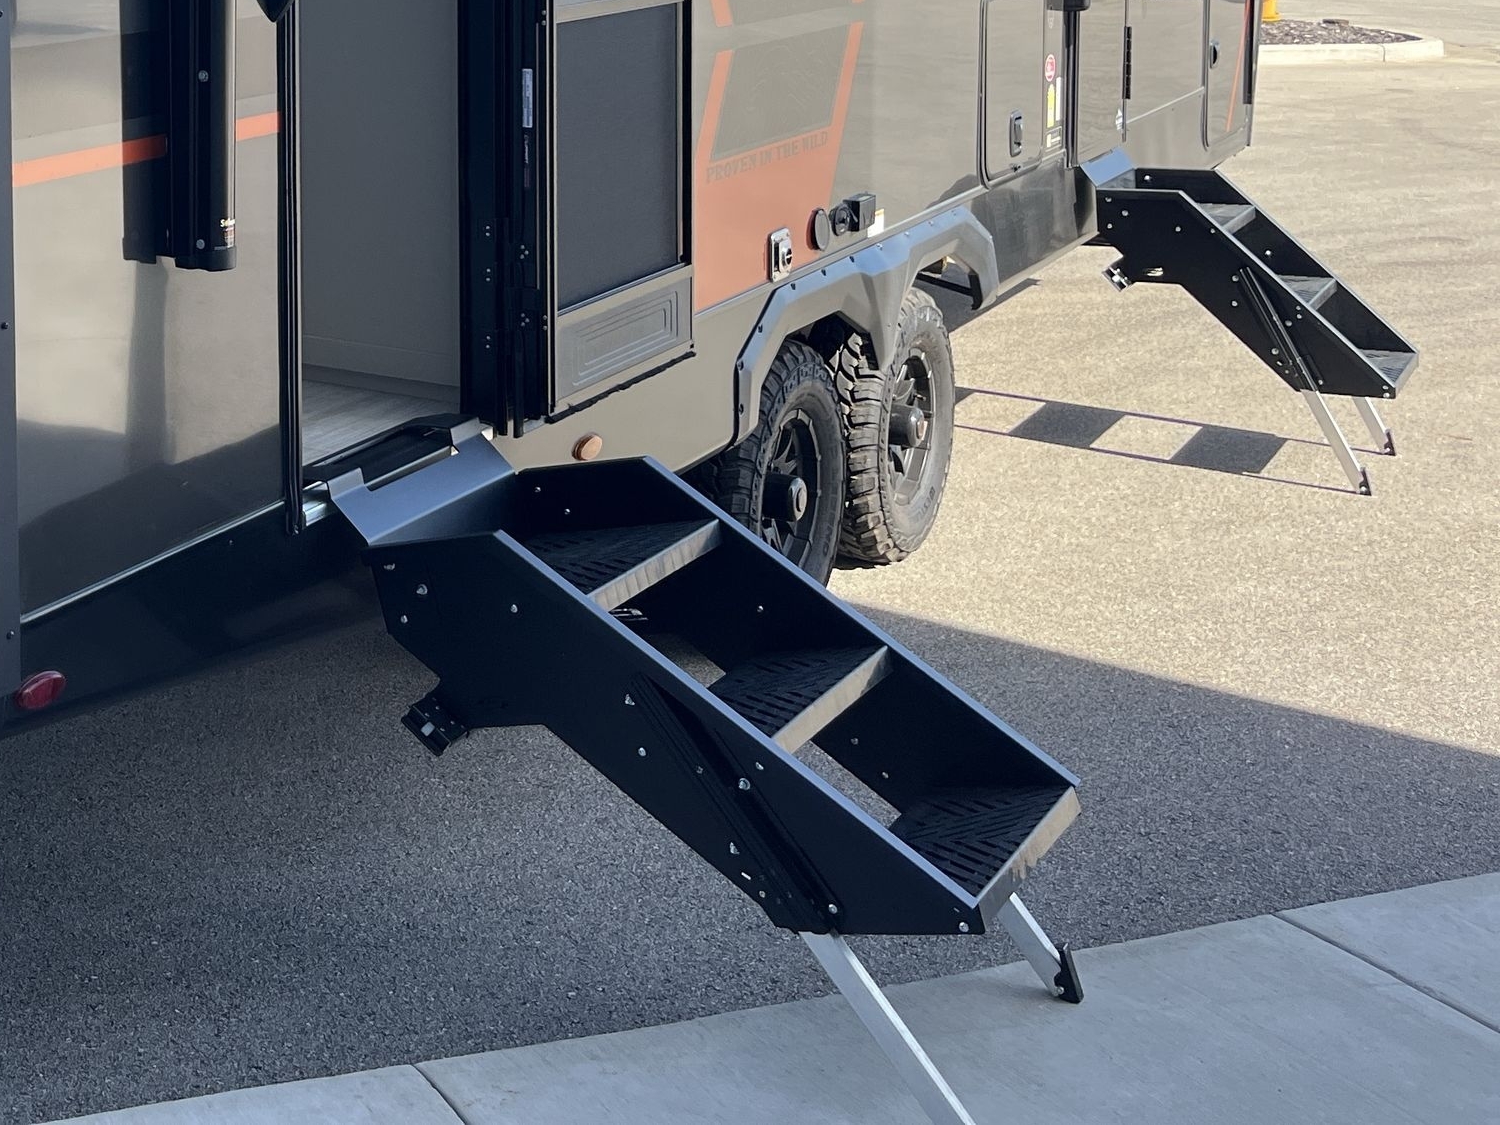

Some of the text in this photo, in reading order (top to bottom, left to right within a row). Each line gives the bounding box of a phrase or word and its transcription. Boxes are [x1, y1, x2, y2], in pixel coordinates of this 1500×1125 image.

[706, 131, 829, 184] PROVEN IN THE WILD
